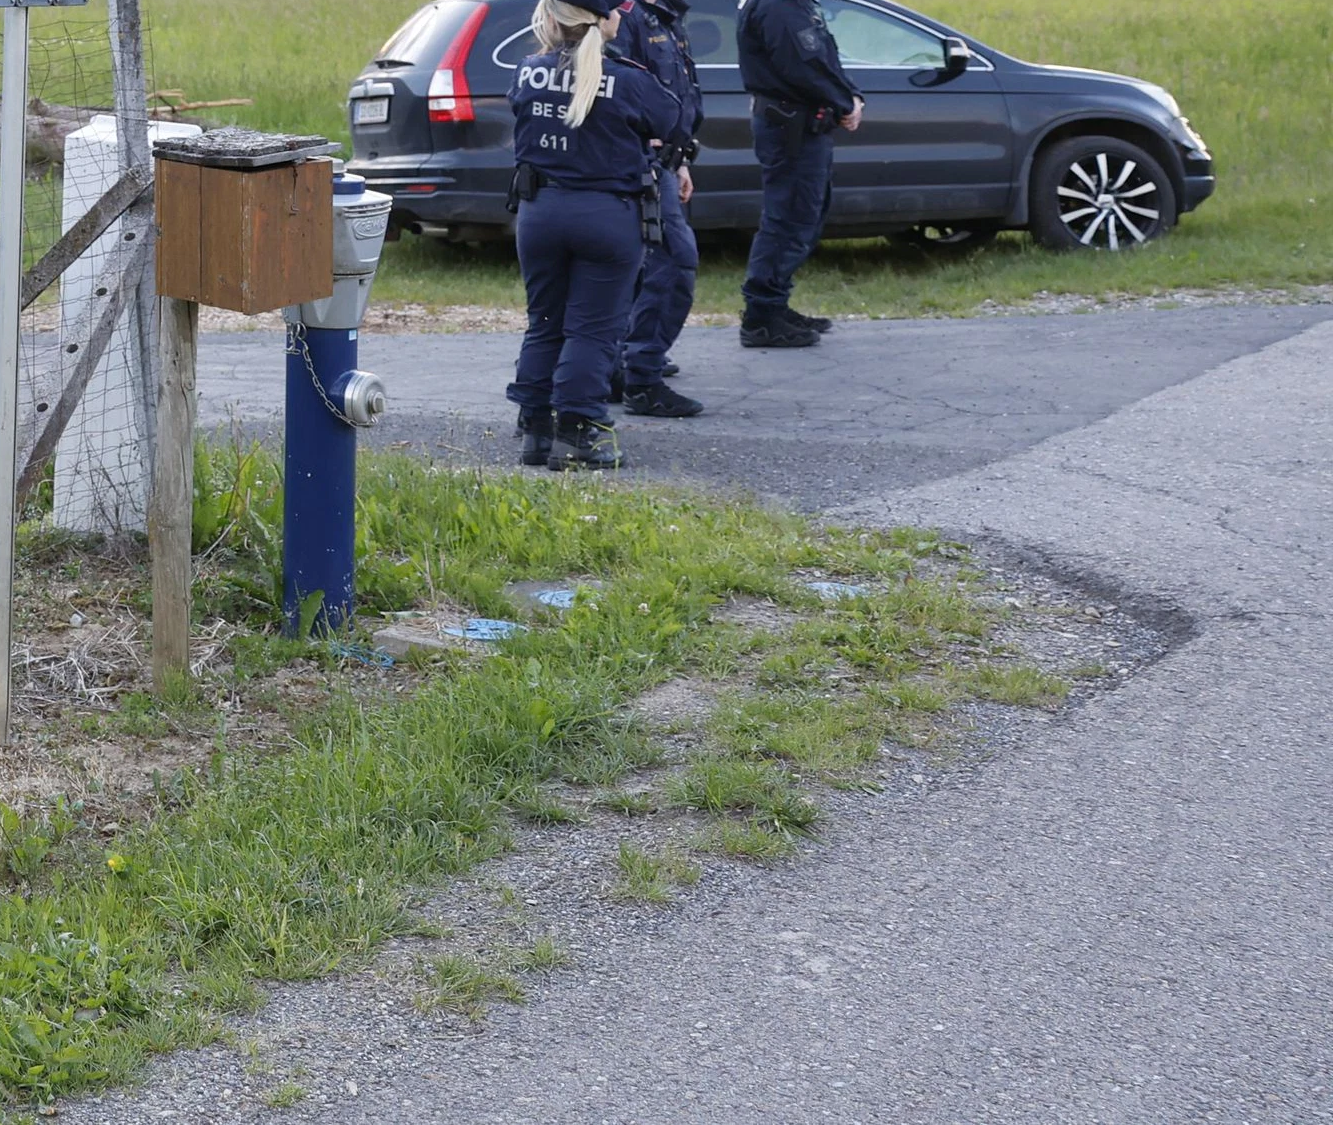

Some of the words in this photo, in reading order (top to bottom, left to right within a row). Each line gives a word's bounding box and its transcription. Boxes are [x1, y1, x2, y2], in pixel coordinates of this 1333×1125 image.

[518, 66, 615, 98] POLIEI
[532, 102, 553, 118] BE
[539, 134, 568, 151] 611
